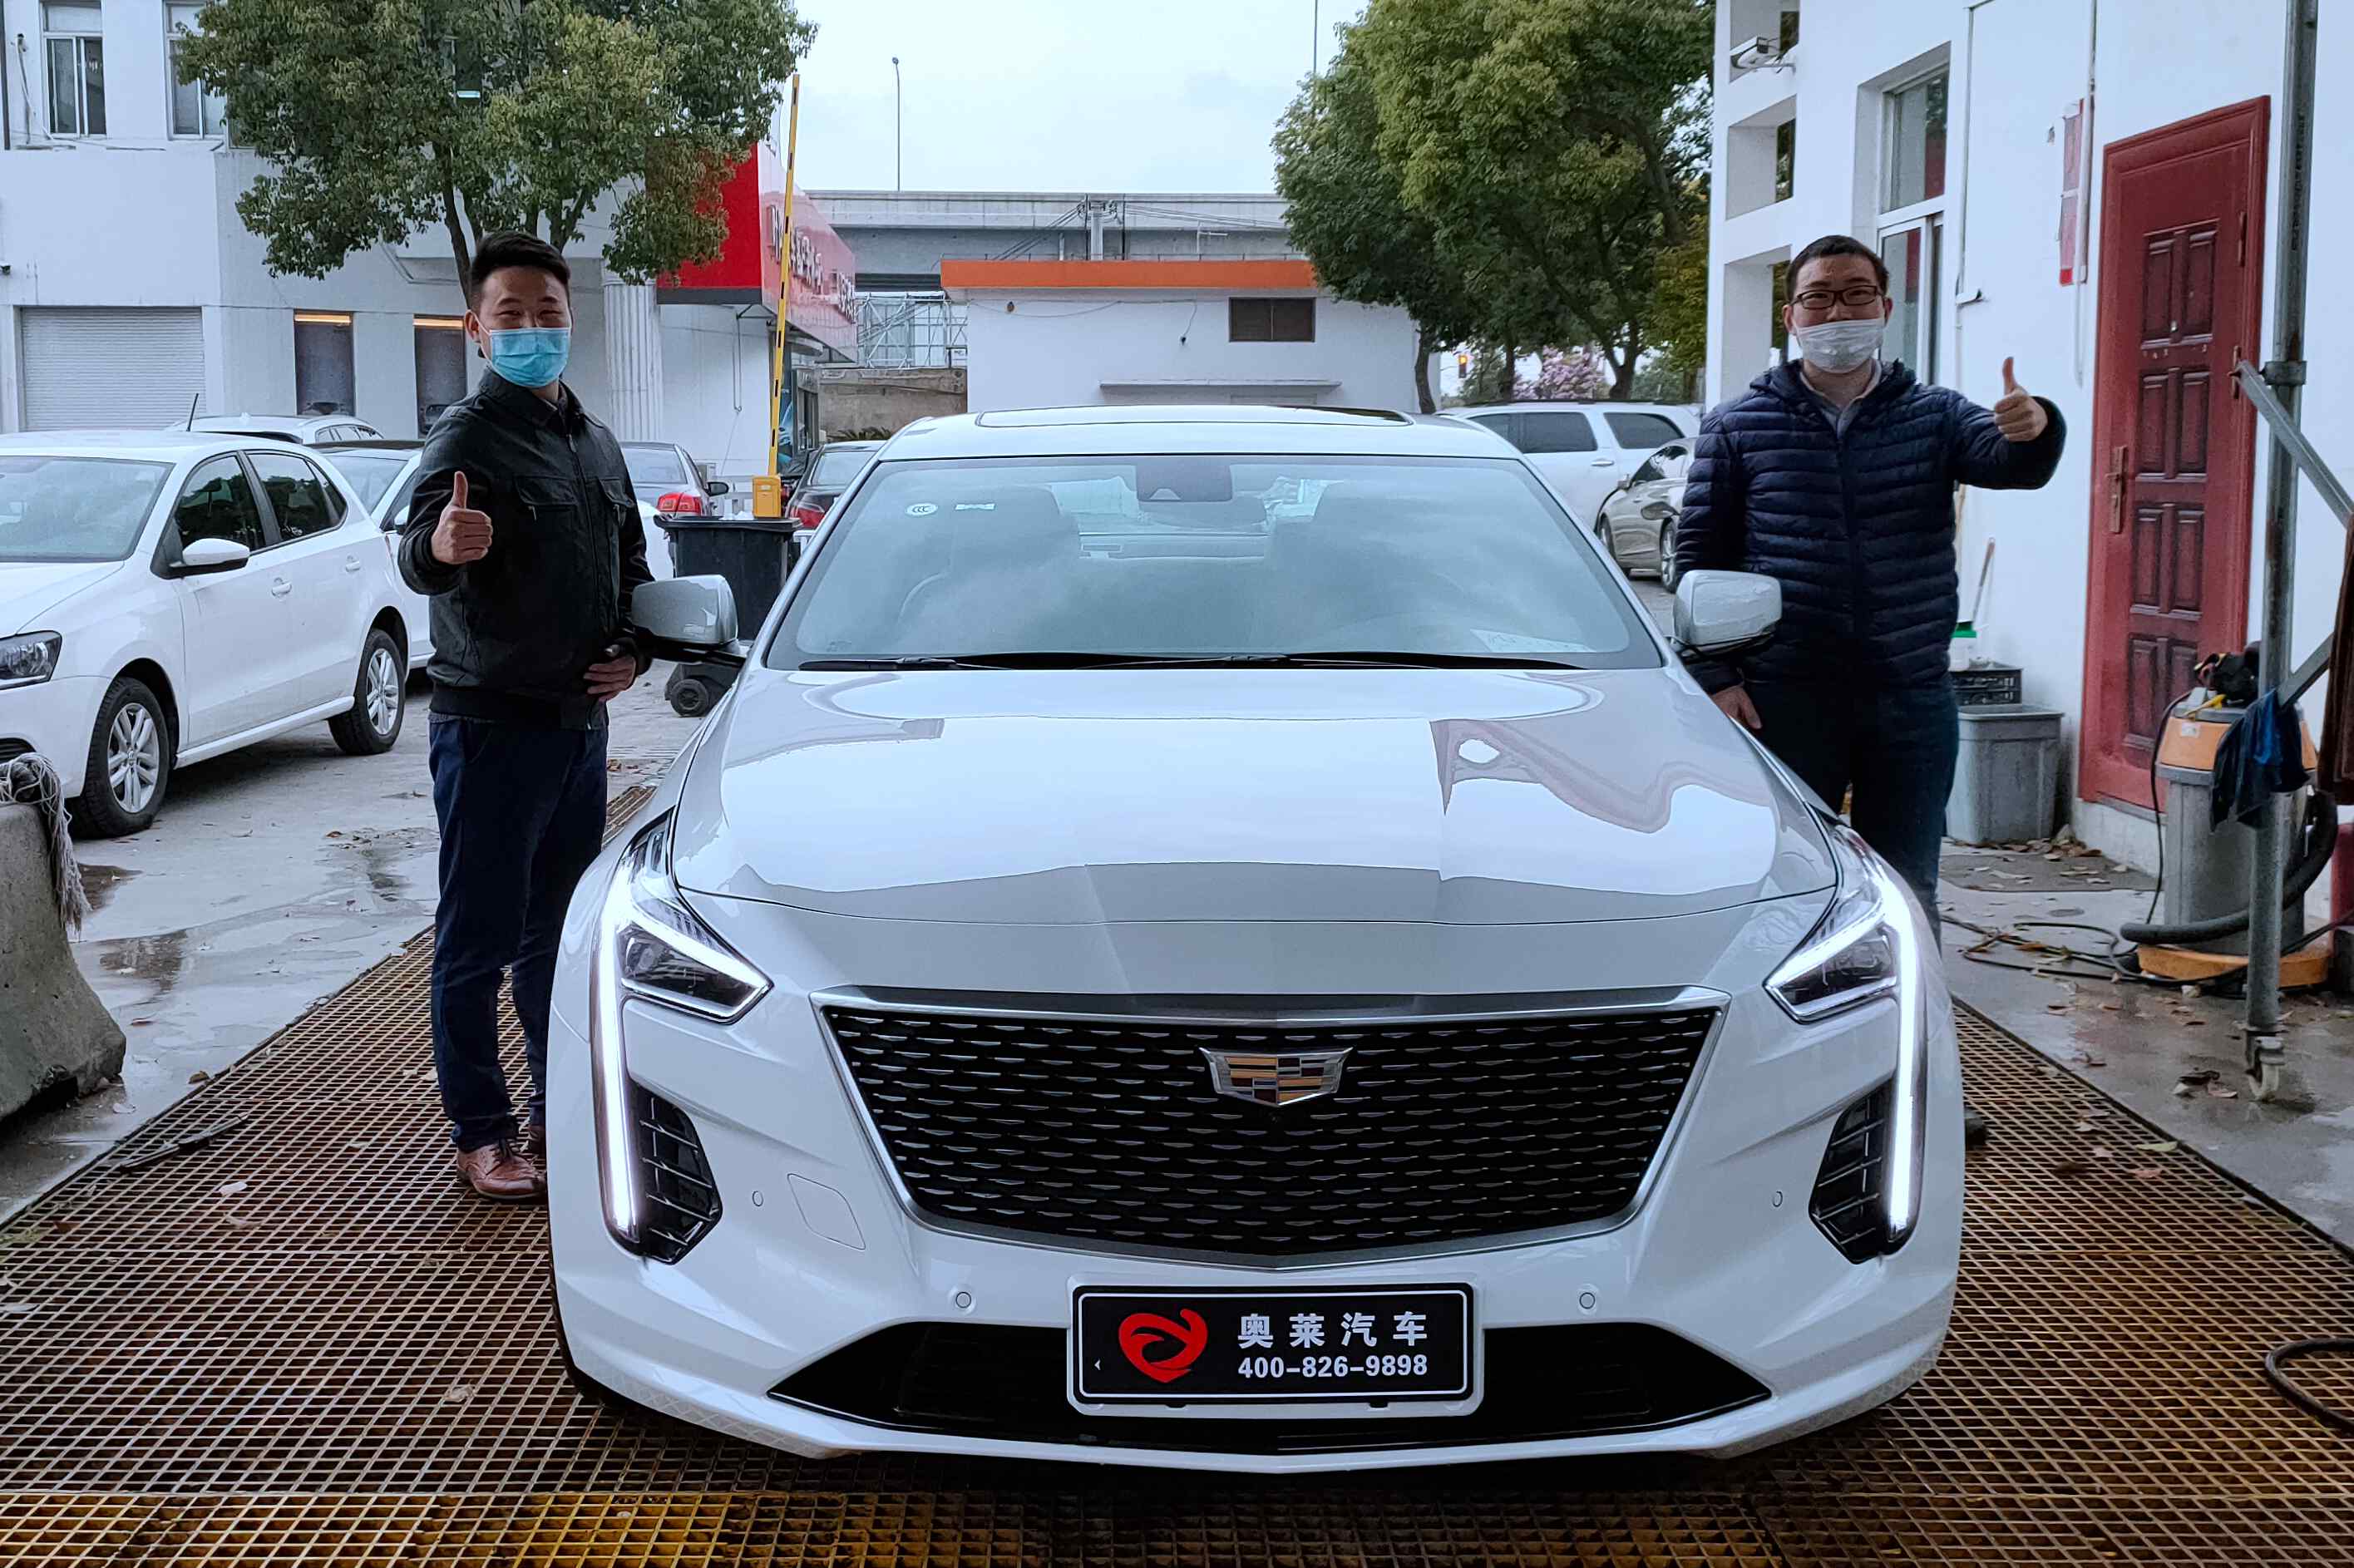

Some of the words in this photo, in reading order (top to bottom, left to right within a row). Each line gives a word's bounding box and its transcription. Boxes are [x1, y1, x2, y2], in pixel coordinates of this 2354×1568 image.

[1237, 1311, 1428, 1349] 奥莱汽车
[1237, 1354, 1428, 1378] 400-826-9898
